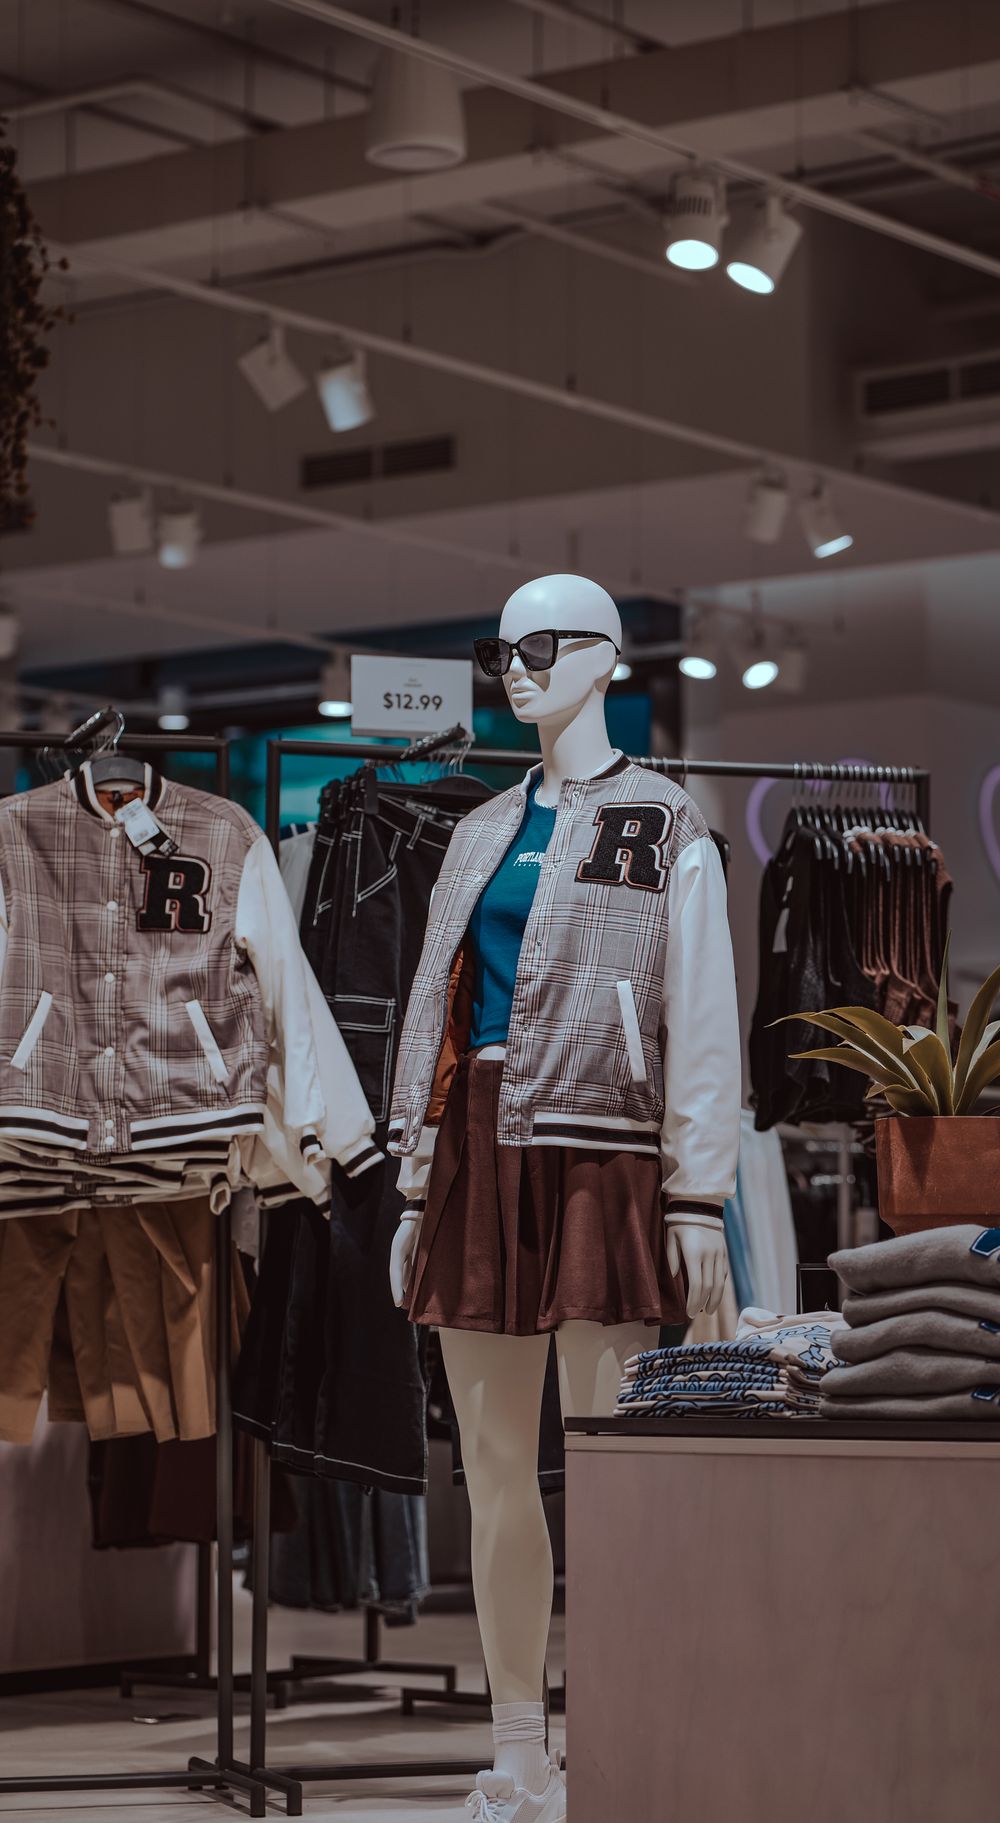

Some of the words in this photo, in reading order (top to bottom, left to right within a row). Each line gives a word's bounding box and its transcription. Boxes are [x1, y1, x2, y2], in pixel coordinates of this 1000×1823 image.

[383, 692, 443, 711] $12.99
[574, 801, 674, 894] R
[136, 855, 212, 934] R
